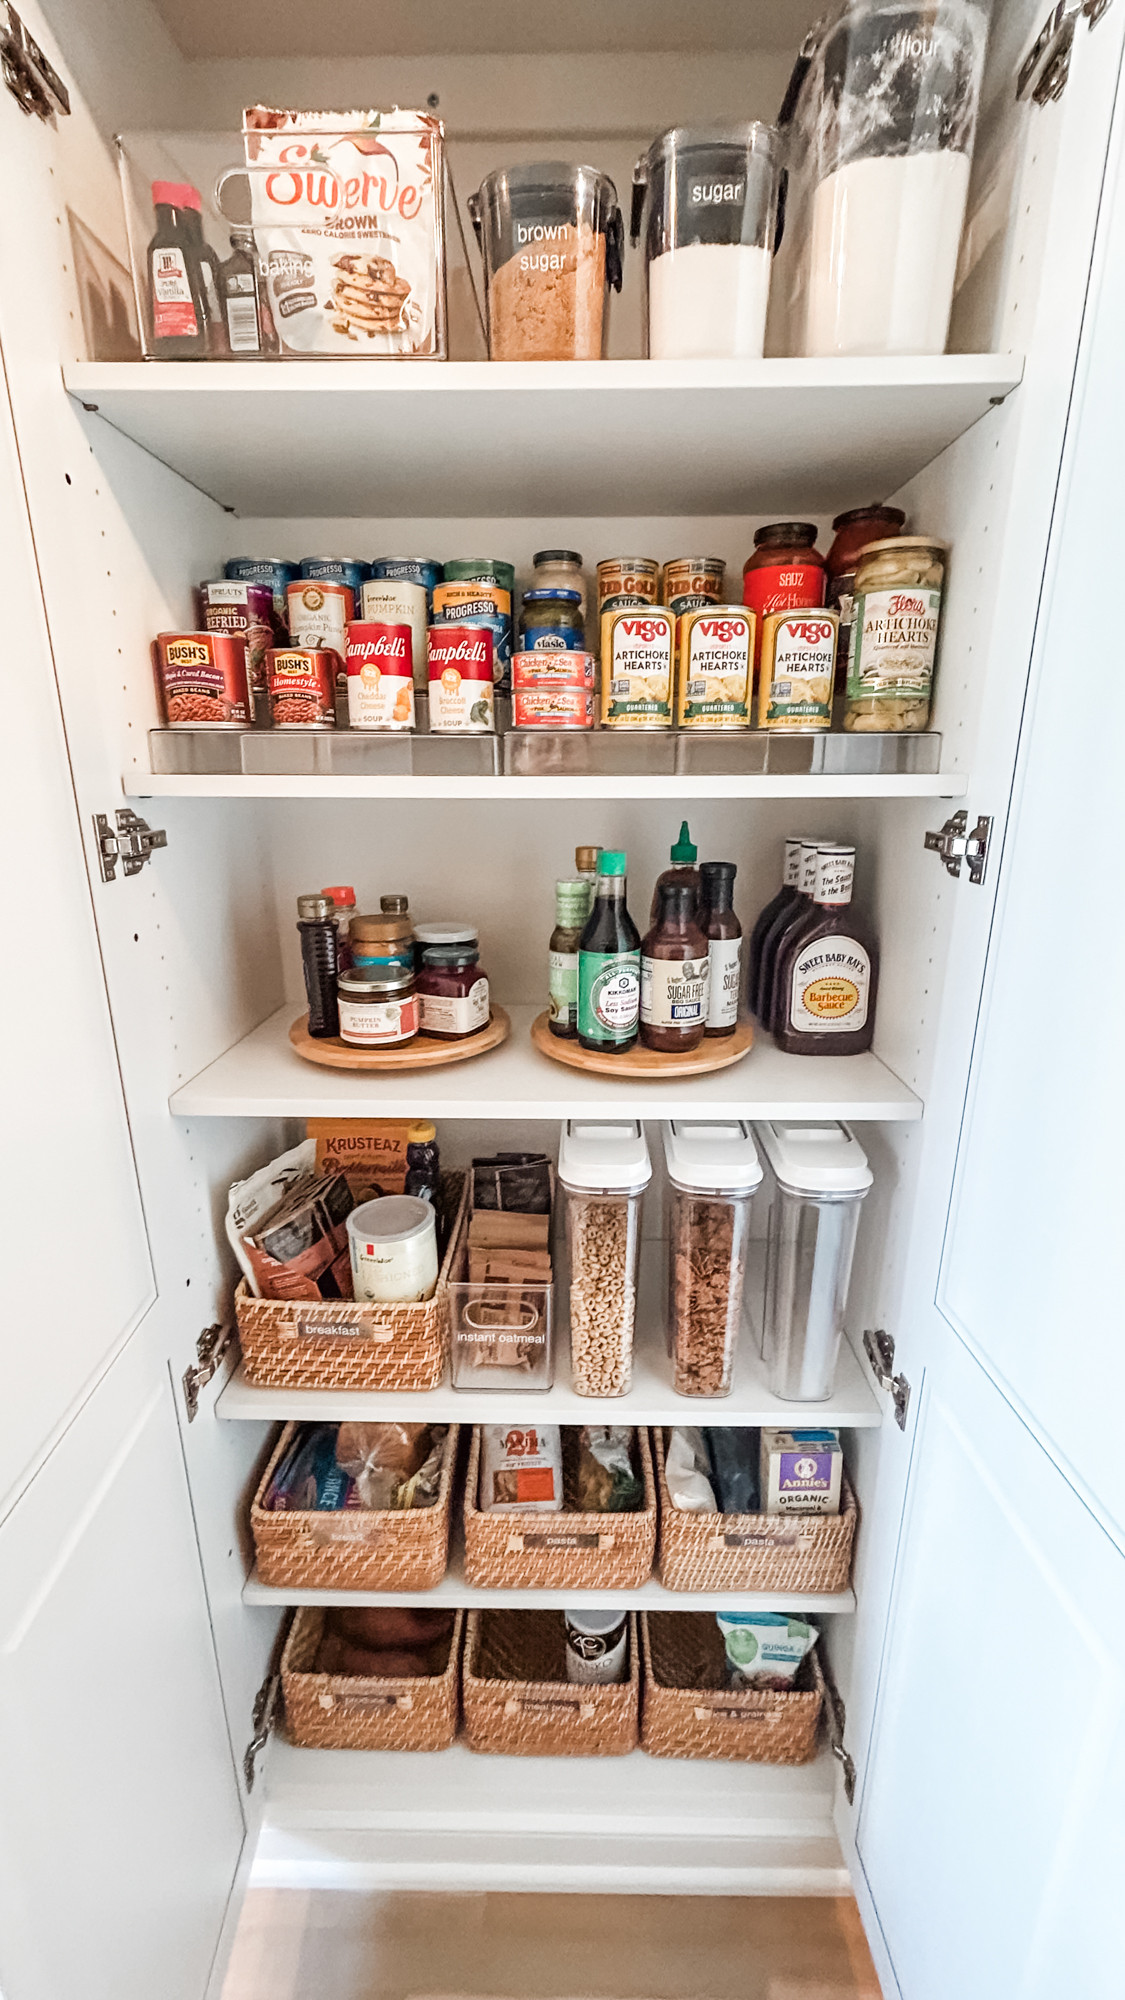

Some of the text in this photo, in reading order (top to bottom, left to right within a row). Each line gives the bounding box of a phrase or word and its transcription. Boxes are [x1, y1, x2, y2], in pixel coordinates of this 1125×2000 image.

[900, 35, 939, 57] flour
[265, 144, 423, 220] Swerve
[692, 183, 741, 204] sugar
[517, 223, 568, 242] brown
[519, 250, 567, 272] sugar
[259, 258, 313, 278] baking
[239, 565, 274, 577] PROGRESSO
[309, 564, 343, 577] PROGRESSO
[386, 565, 421, 577] PROGRESSO
[778, 572, 804, 587] SAUZ
[206, 607, 238, 616] ORGANIC
[445, 601, 495, 620] PROGRESSO
[206, 616, 247, 629] REFRIED
[865, 617, 937, 633] ARTICHOKE
[877, 631, 930, 643] HEARTS
[168, 646, 206, 661] BUSH'S
[615, 650, 669, 661] ARTICHOKE
[692, 650, 747, 661] ARTICHOKE
[777, 652, 832, 663] ARTICHOKE
[276, 659, 309, 672] BUSH'S
[624, 661, 662, 671] HEARTS
[700, 661, 739, 671] HEARTS
[786, 663, 825, 673] HEARTS
[273, 677, 318, 688] Homestyle
[443, 719, 463, 727] SOUP
[822, 877, 834, 886] The
[820, 888, 826, 897] is
[827, 887, 839, 895] the
[798, 953, 866, 975] SWEET BABY RAY'S
[667, 981, 705, 1000] SUGAR FREE
[809, 992, 854, 1002] Barbecue
[621, 1004, 638, 1012] Sauce
[325, 1137, 401, 1154] KRUSTEAZ
[305, 1323, 360, 1337] breakfast
[457, 1331, 546, 1345] instant oatmeal
[506, 1429, 541, 1457] 21
[782, 1477, 829, 1489] Annie's
[779, 1494, 830, 1505] ORGANIC
[546, 1536, 578, 1547] pasta
[743, 1536, 775, 1547] pasta
